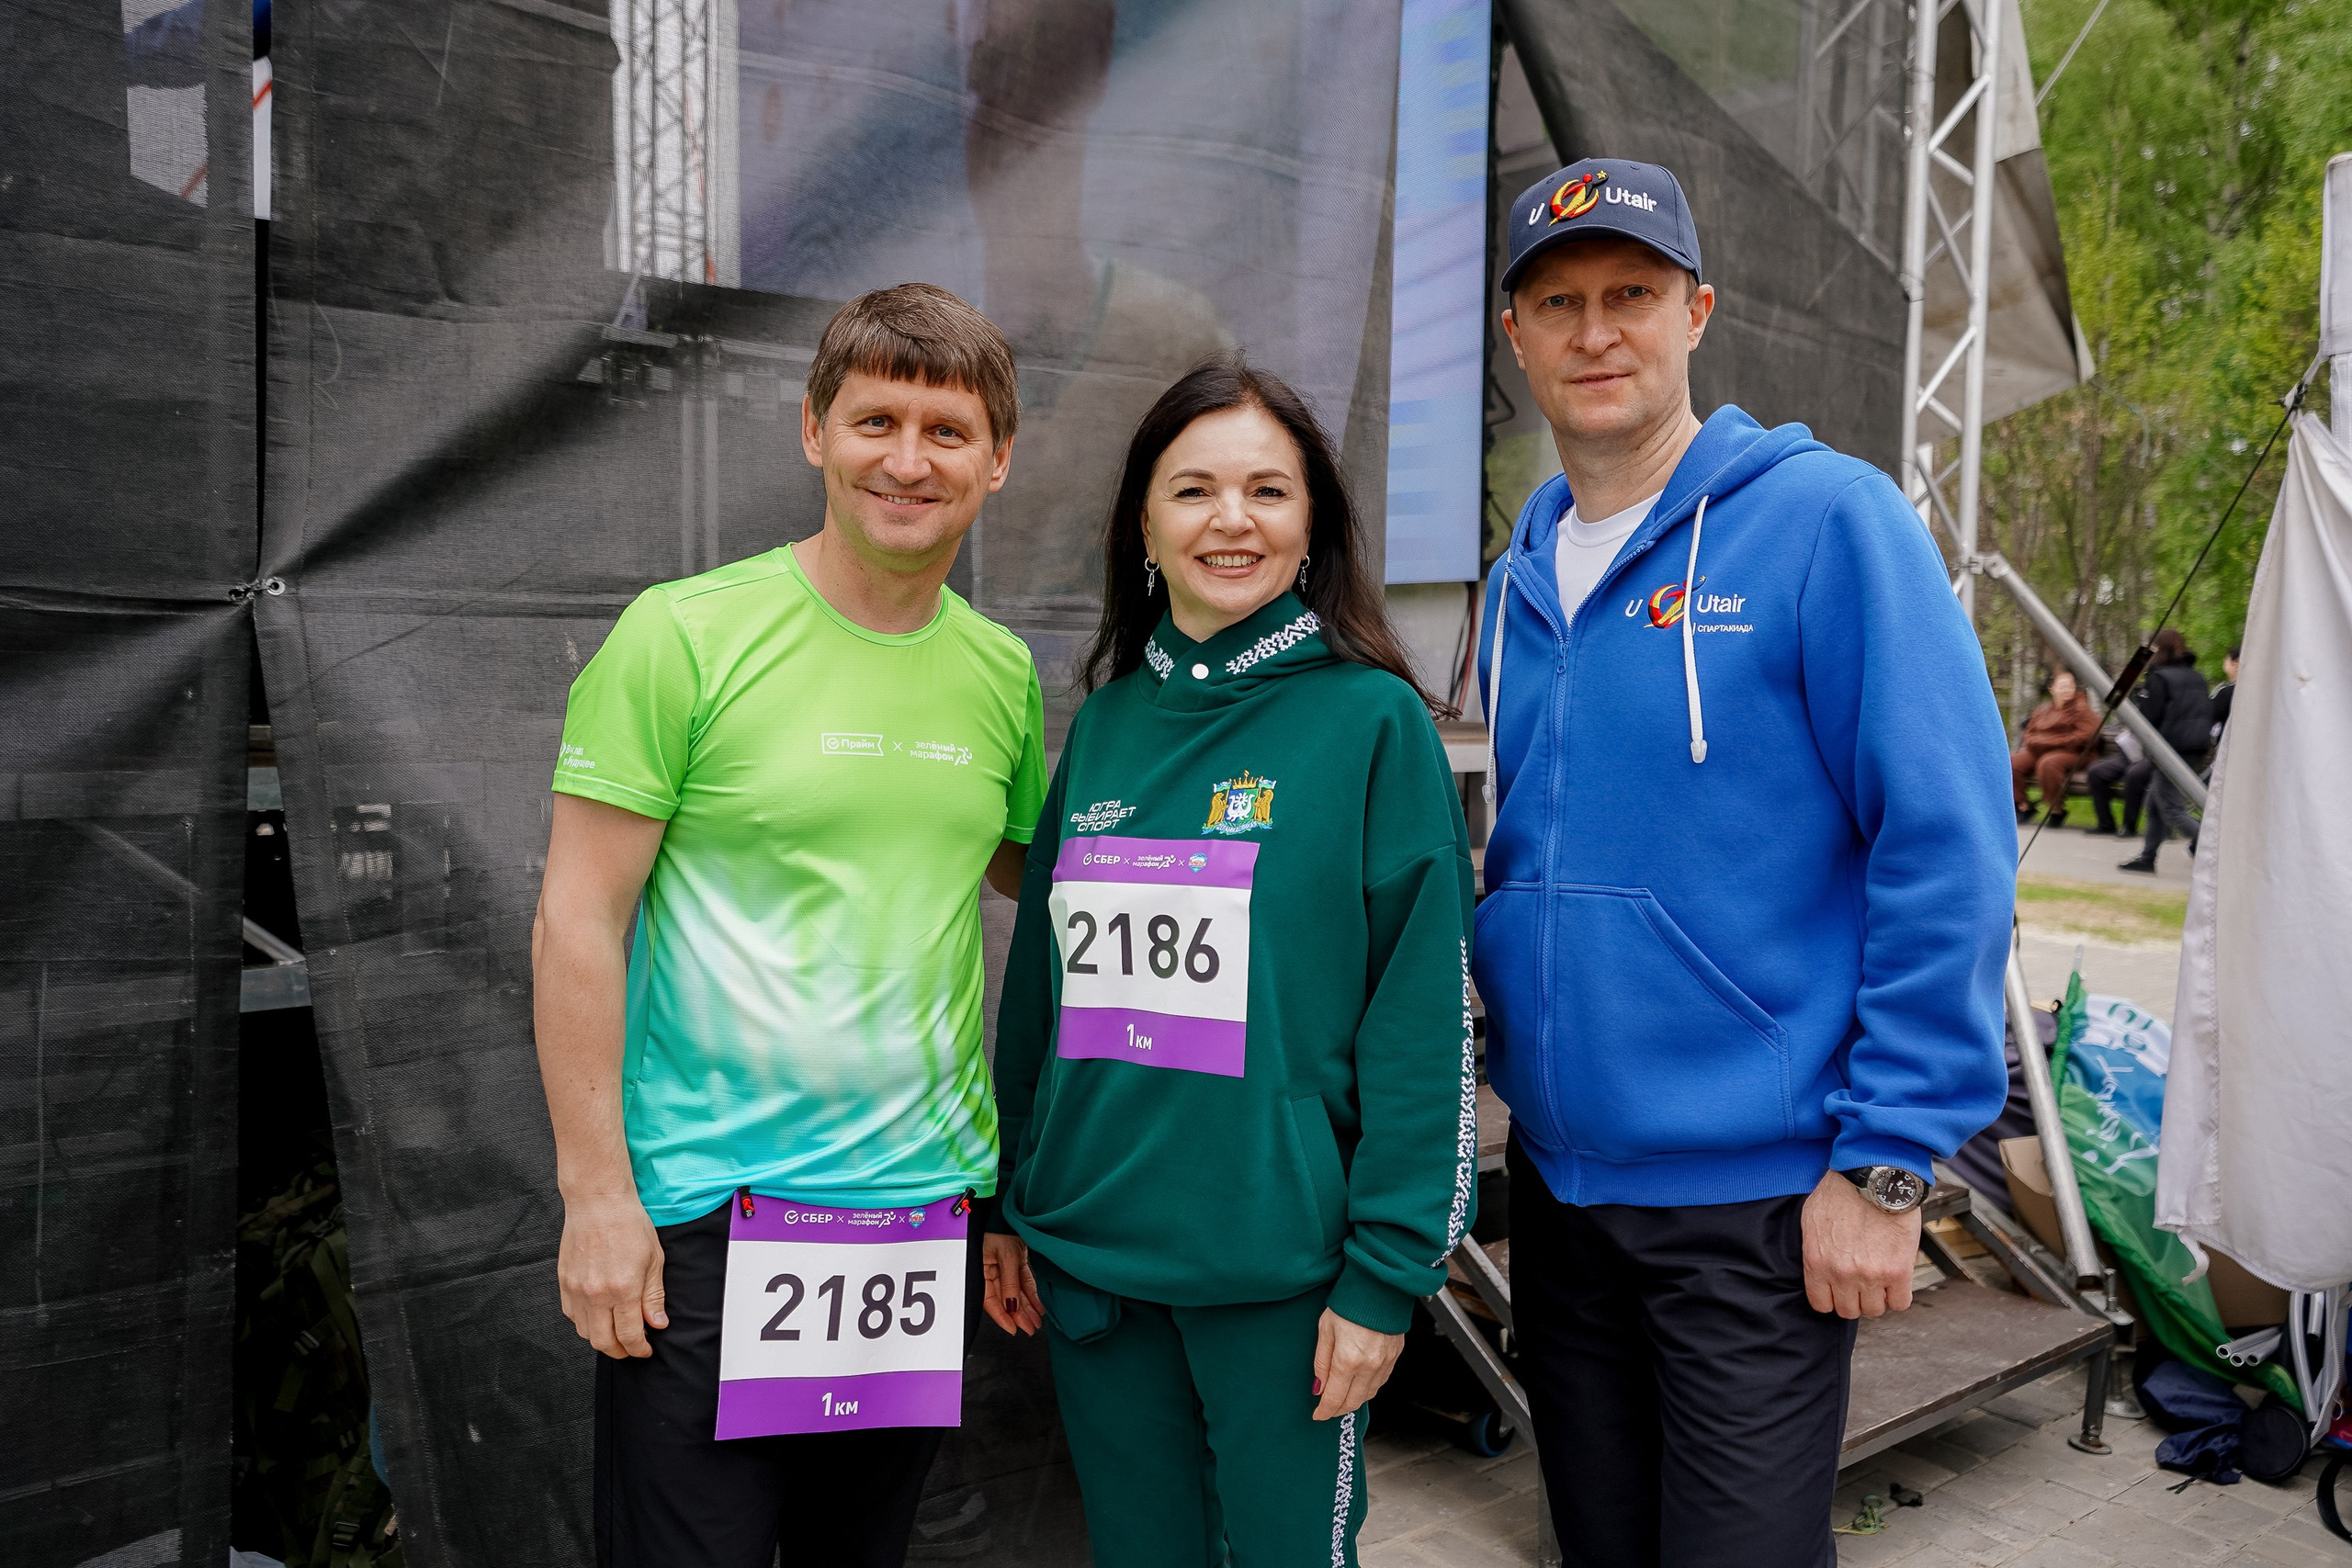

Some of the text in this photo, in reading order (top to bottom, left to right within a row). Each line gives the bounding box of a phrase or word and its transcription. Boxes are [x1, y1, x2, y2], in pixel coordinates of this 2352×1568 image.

[1606, 187, 1657, 212] Utair
[1696, 593, 1746, 614] Utair
[1697, 624, 1754, 634] СПАРТАКИАДА
[841, 739, 876, 750] Прайм
[915, 740, 956, 753] зелёный
[910, 750, 954, 761] марафон
[1089, 799, 1122, 813] ЮГРА
[1069, 806, 1137, 823] ВЫБИРАЕТ
[1076, 818, 1121, 832] СПОРТ
[1093, 854, 1121, 865] СБЕР
[1067, 910, 1221, 984] 2186
[800, 1213, 833, 1224] СБЕР
[847, 1218, 879, 1226] марафон
[759, 1269, 937, 1341] 2185
